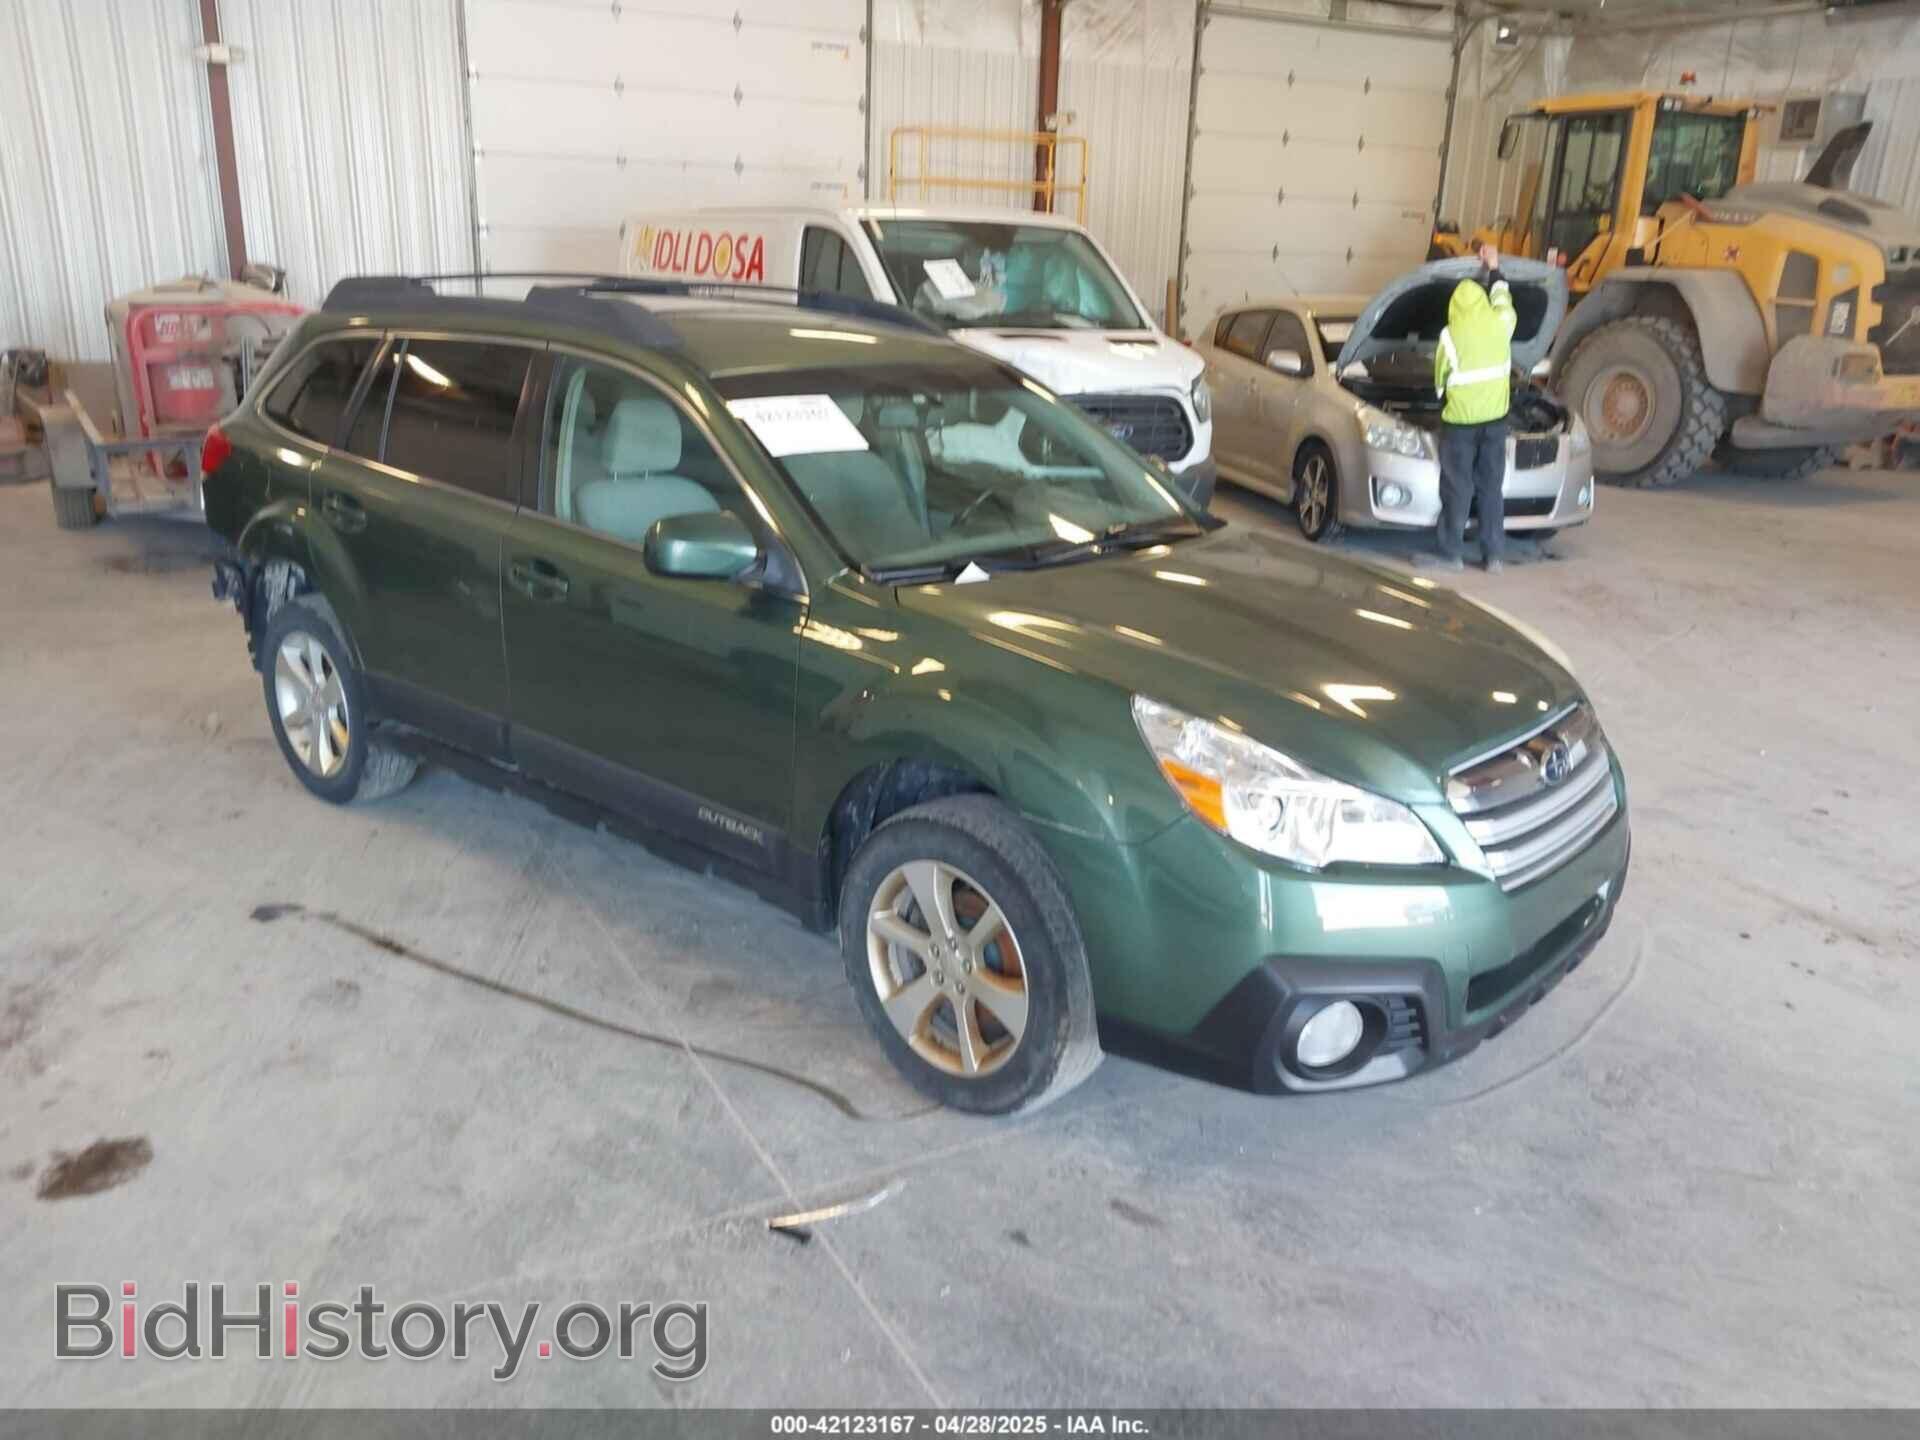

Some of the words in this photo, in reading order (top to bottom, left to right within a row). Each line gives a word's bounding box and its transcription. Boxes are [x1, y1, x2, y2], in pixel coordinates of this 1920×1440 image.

[652, 229, 693, 272] IDLI
[694, 231, 765, 281] DOSA
[697, 806, 764, 846] OUTBACK
